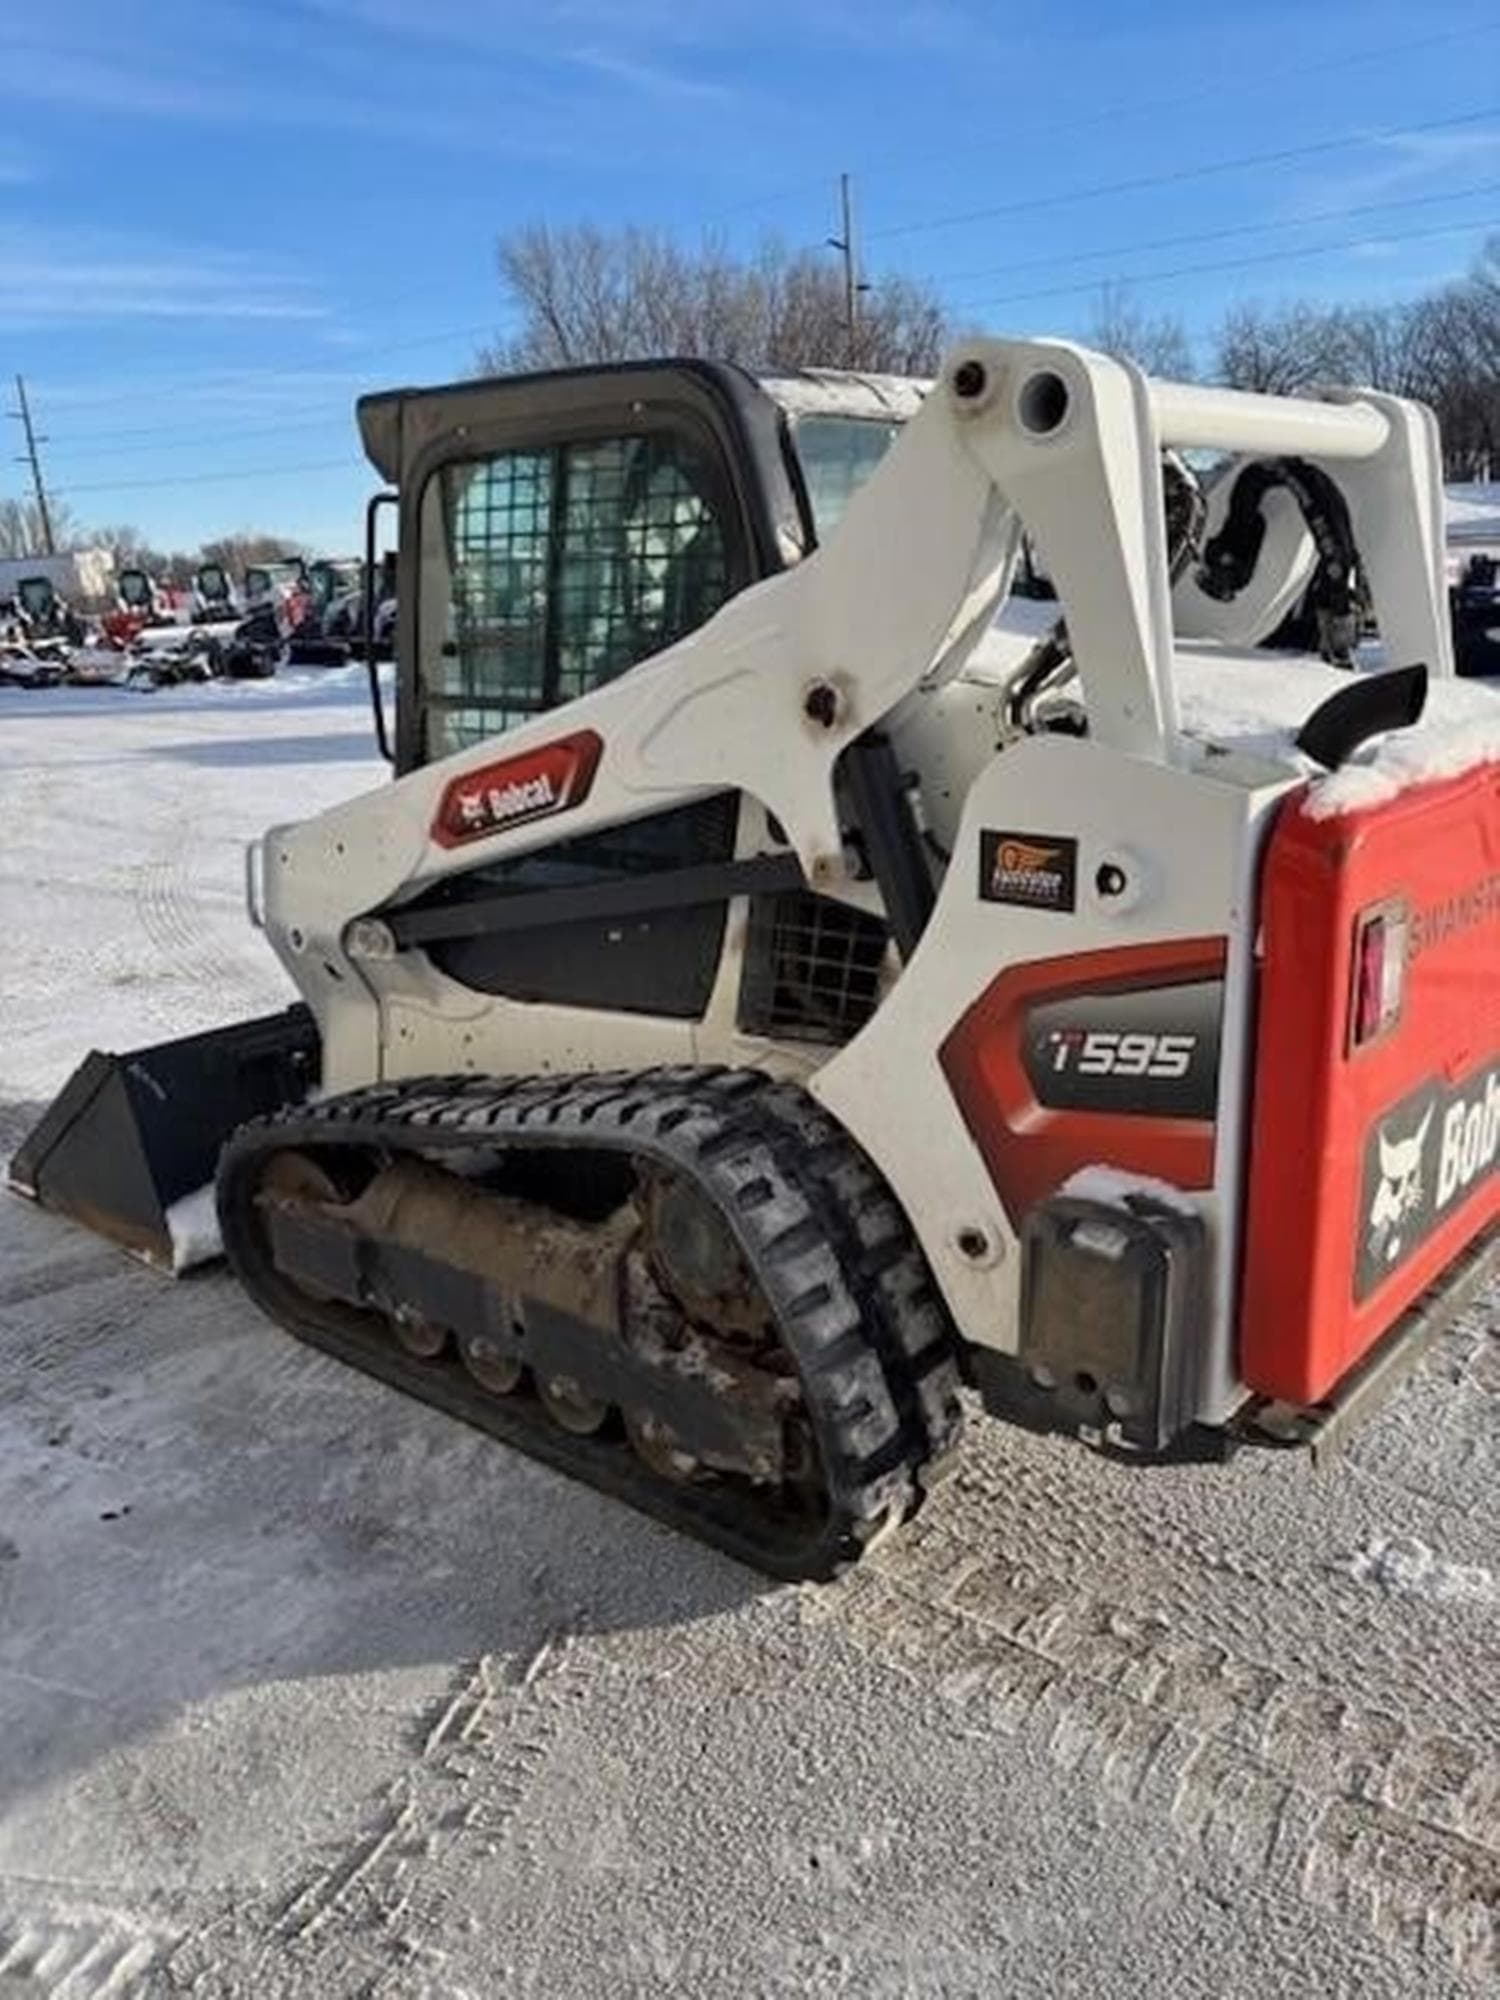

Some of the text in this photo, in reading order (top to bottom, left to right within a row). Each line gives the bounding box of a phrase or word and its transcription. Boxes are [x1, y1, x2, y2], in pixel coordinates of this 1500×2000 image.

[488, 773, 554, 820] Bobcat
[1049, 1030, 1196, 1077] T595
[1436, 1073, 1500, 1209] Bob
